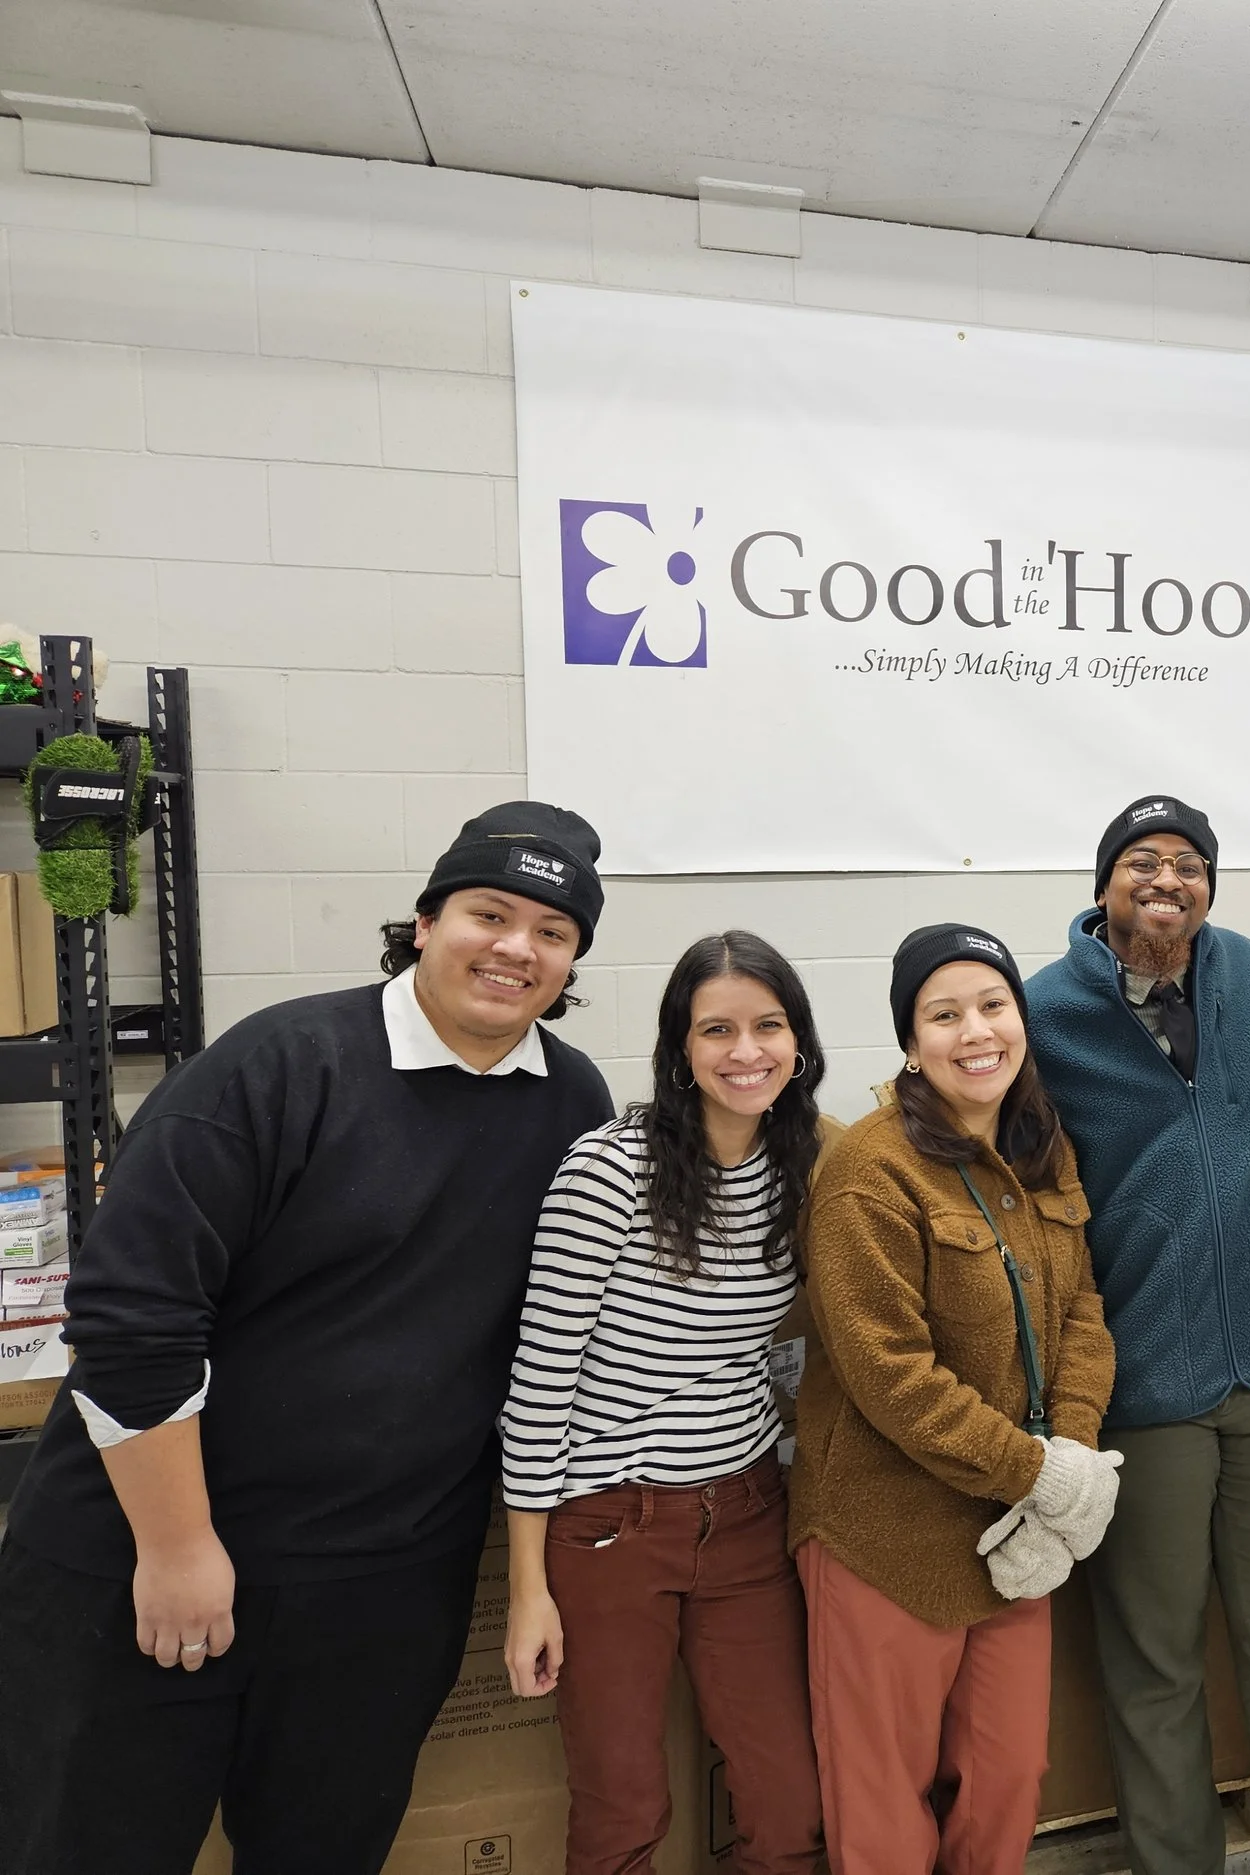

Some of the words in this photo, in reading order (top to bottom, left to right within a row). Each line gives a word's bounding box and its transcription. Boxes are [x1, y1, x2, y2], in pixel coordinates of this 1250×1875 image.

[731, 530, 1011, 628] Good
[1021, 558, 1044, 582] in
[1013, 590, 1049, 614] the
[954, 650, 1052, 685] Making
[1056, 655, 1081, 681] A
[1087, 655, 1209, 688] Difference
[57, 784, 124, 801] LACROSSE
[1131, 806, 1153, 818] Hope
[1133, 810, 1168, 824] Academy
[520, 853, 550, 869] Hope
[517, 862, 565, 886] Academy
[475, 1674, 502, 1685] Folha
[430, 1730, 456, 1742] solar
[458, 1725, 489, 1737] direta
[492, 1722, 506, 1732] ou
[508, 1715, 550, 1730] coloque
